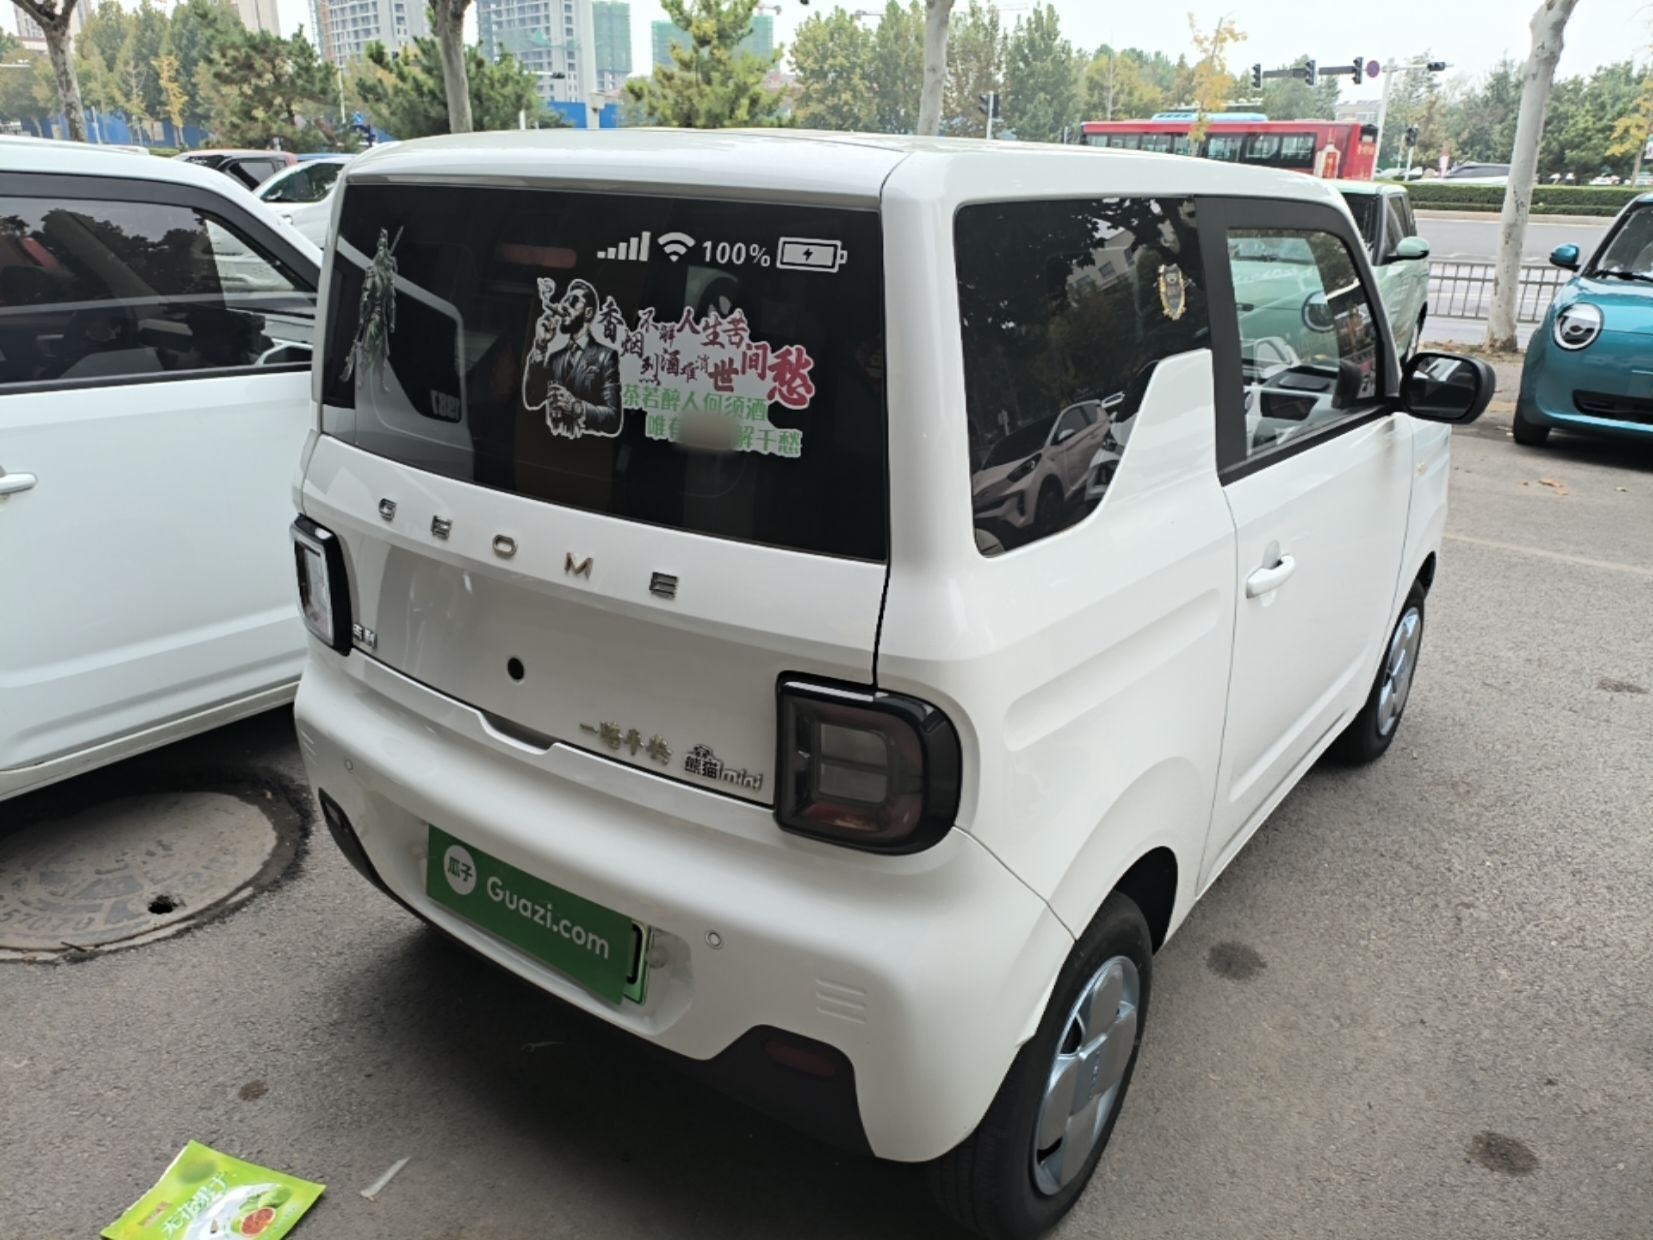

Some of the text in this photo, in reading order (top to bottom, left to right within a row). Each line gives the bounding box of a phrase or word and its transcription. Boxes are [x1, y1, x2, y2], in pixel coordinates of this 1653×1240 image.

[702, 240, 771, 268] 100%
[598, 305, 749, 357] 香烟不解人生苦
[623, 384, 768, 422] 茶若醉人何须酒
